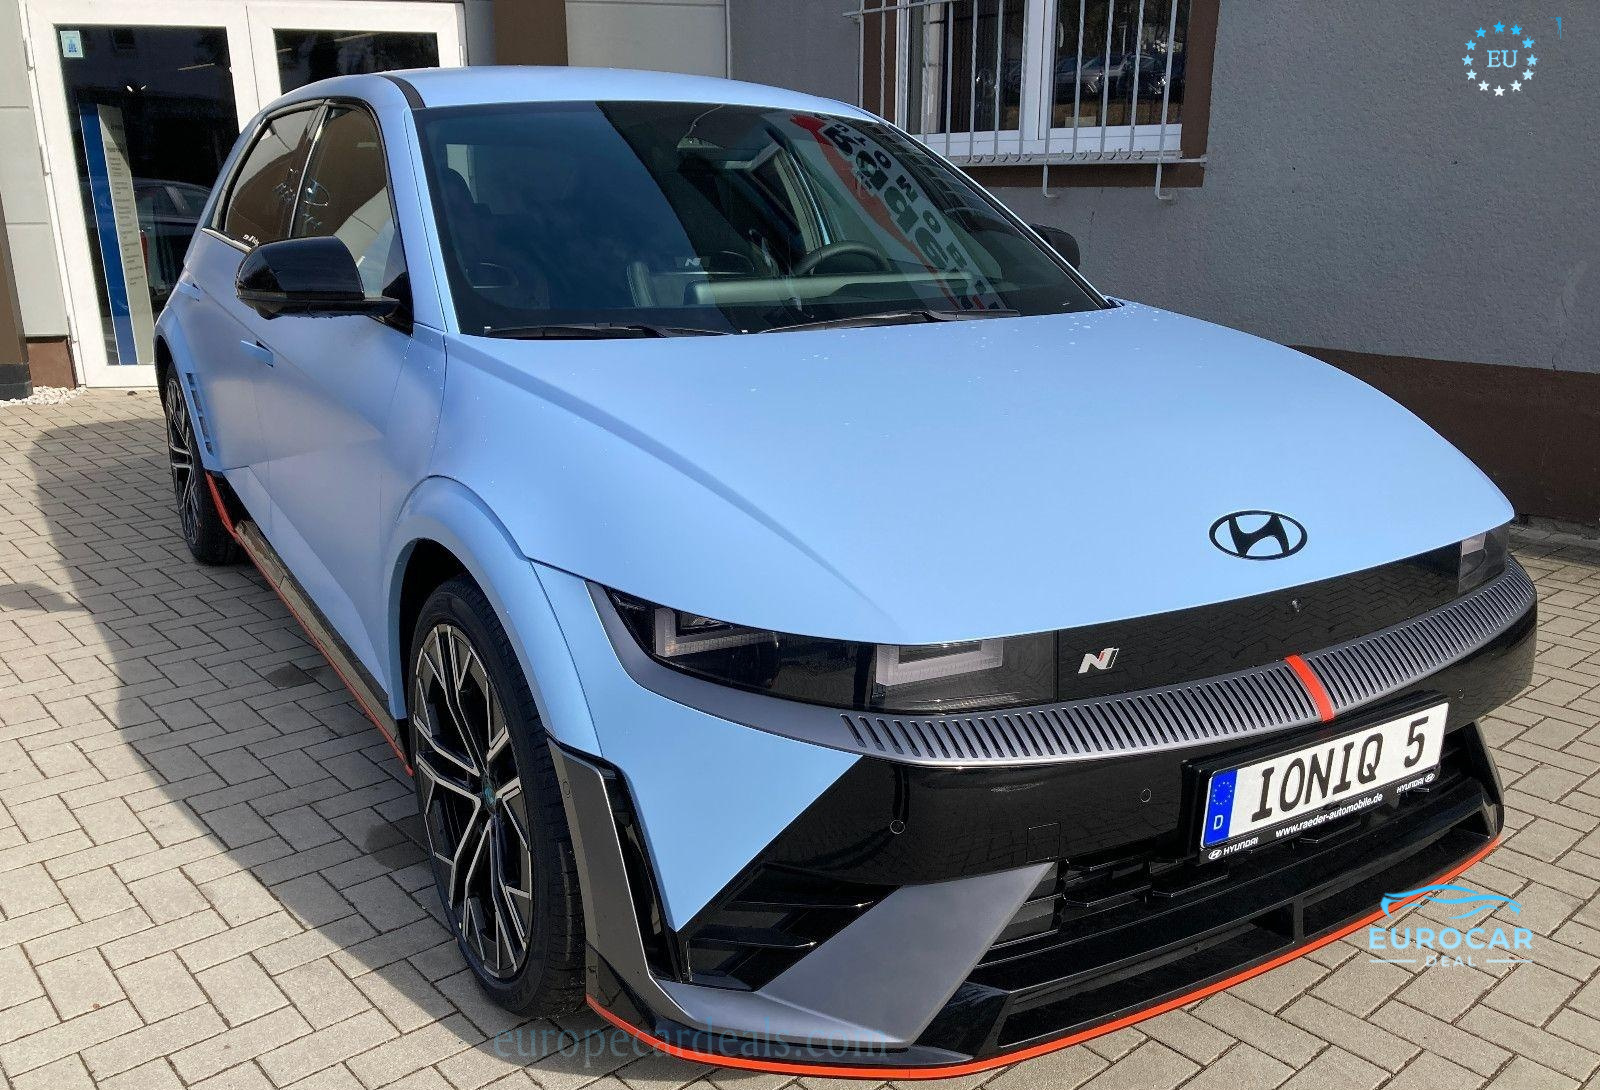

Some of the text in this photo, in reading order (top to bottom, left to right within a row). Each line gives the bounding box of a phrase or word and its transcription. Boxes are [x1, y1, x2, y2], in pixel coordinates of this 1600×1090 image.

[1077, 646, 1120, 674] N
[1251, 715, 1430, 822] IONIQ 5
[1397, 777, 1425, 794] HYUNDAI
[1213, 814, 1224, 830] D
[1275, 792, 1383, 838] www.raeder-automobile.de
[1223, 836, 1259, 856] HYUNDAI
